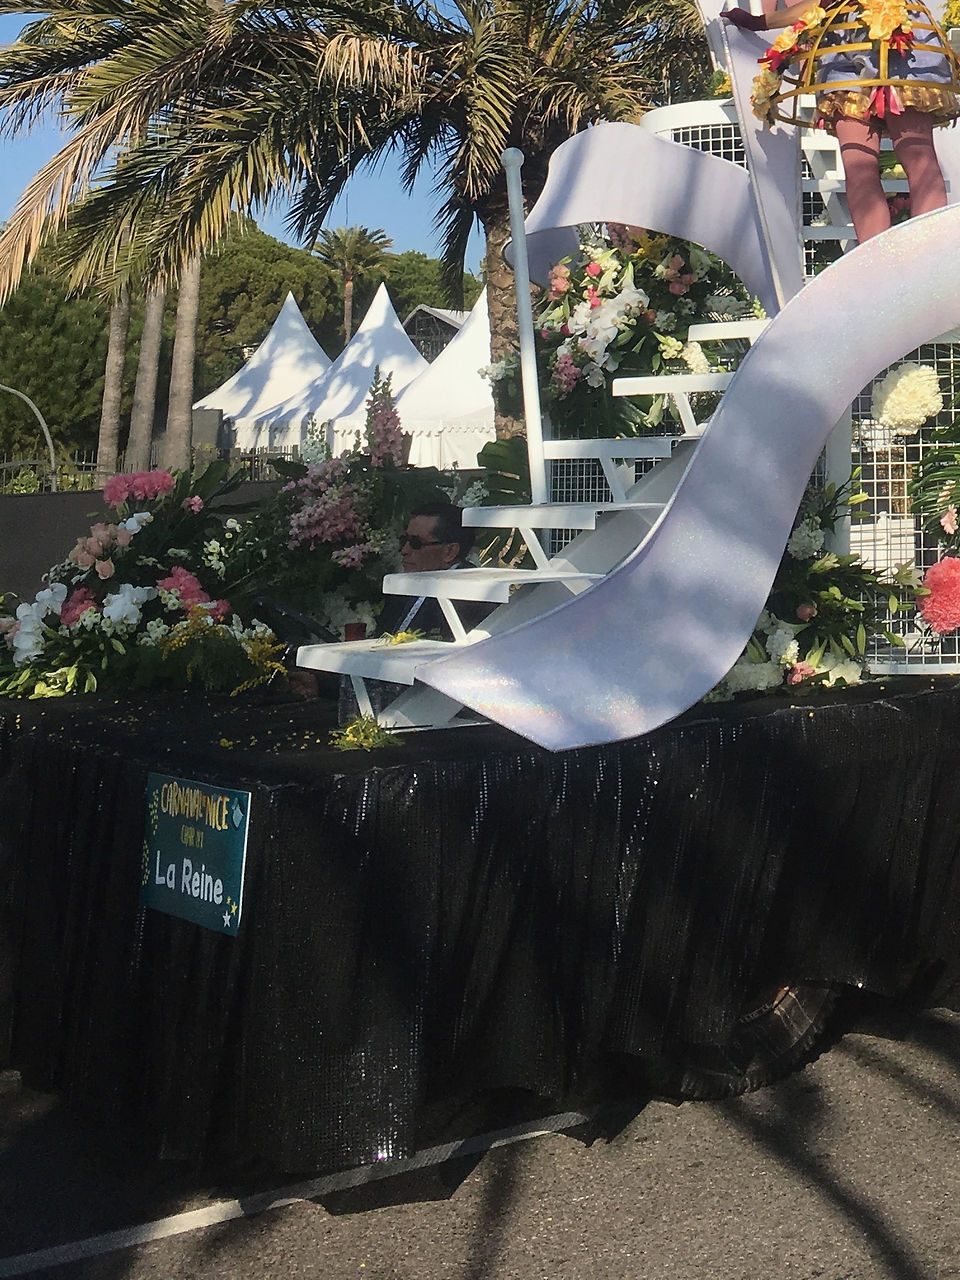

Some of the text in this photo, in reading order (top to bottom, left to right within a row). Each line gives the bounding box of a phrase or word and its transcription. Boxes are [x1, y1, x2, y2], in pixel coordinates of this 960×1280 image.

[161, 781, 230, 831] CARNAVAL NICE
[155, 850, 224, 905] La Reine
